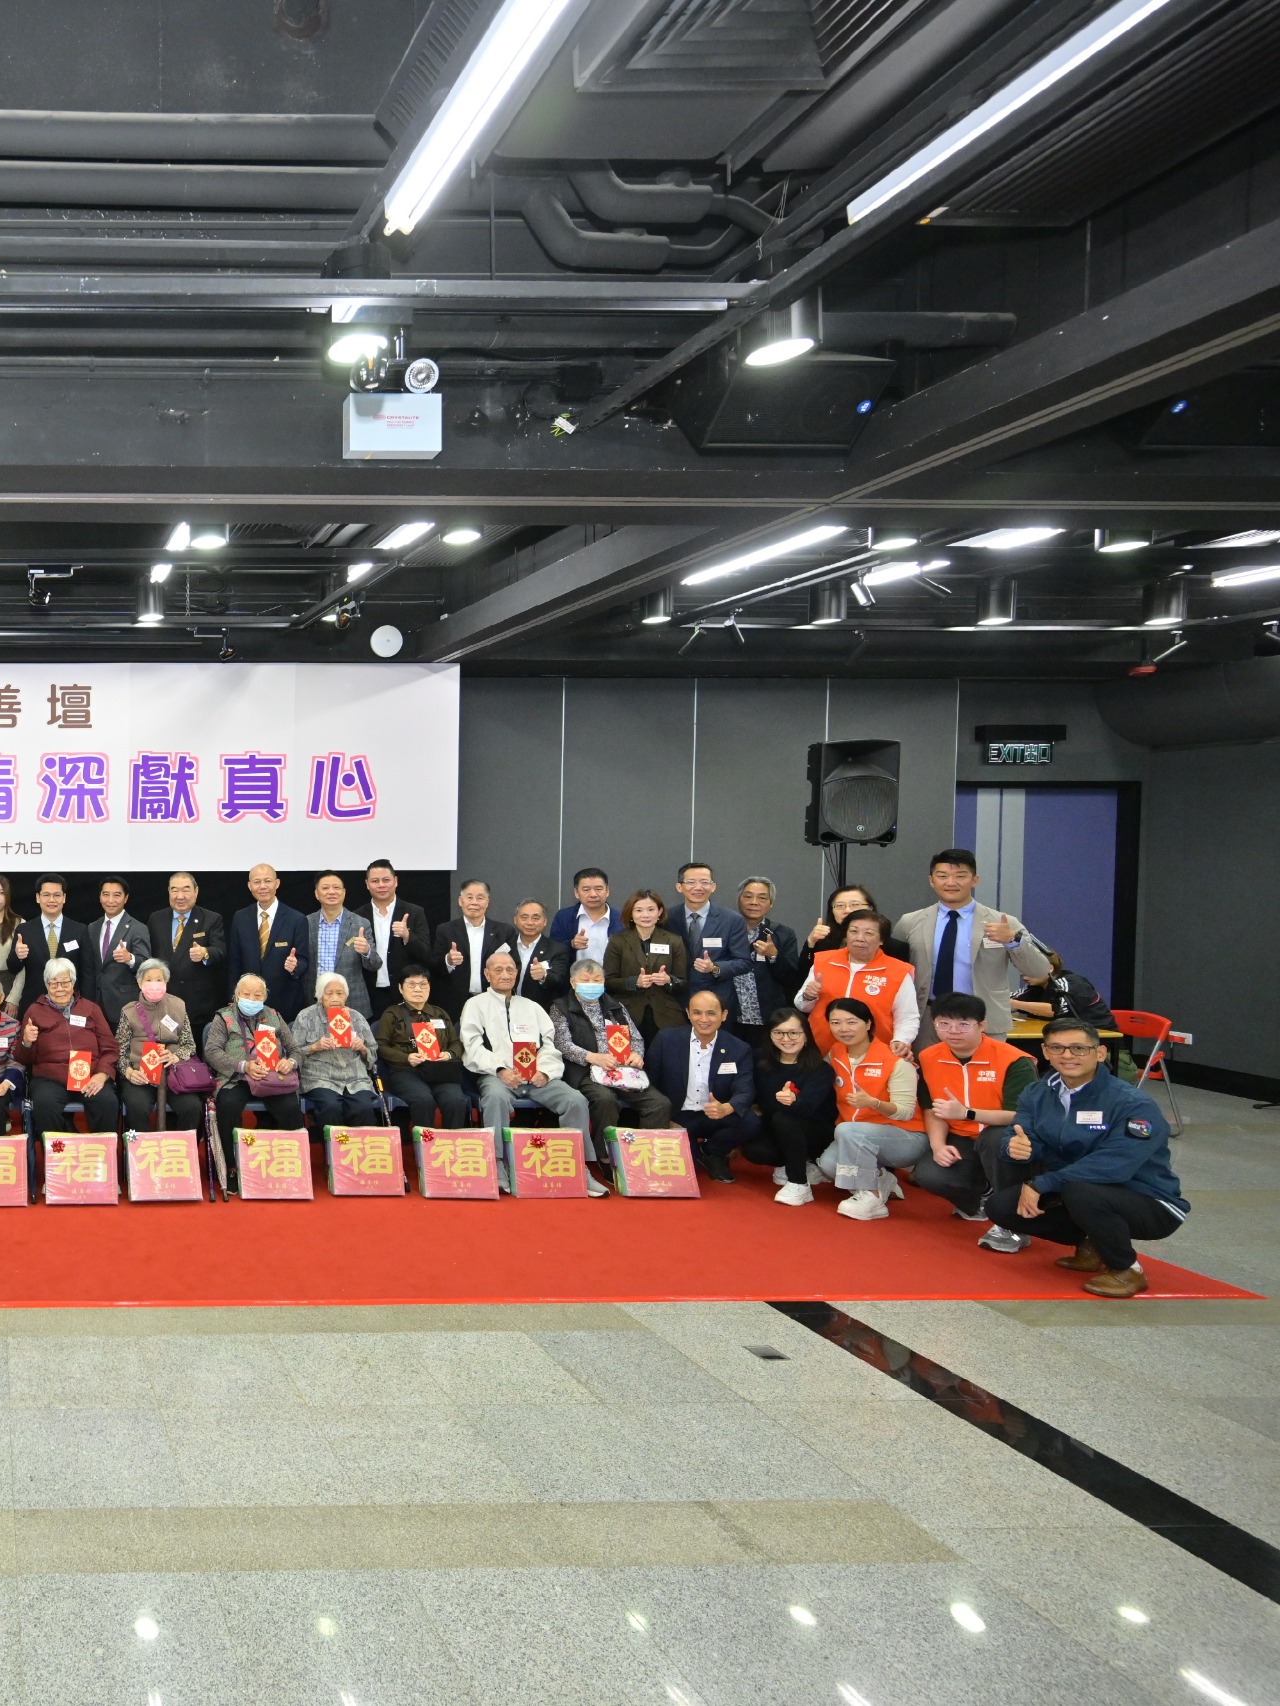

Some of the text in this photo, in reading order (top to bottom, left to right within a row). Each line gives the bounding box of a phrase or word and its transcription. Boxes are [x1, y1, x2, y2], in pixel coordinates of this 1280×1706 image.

[988, 743, 1024, 763] EXIT
[53, 1144, 108, 1183] 福
[135, 1139, 191, 1178] 福
[248, 1139, 302, 1179] 福
[340, 1135, 393, 1175] 福
[429, 1137, 486, 1177] 福
[521, 1139, 575, 1178] 福
[629, 1136, 686, 1176] 福
